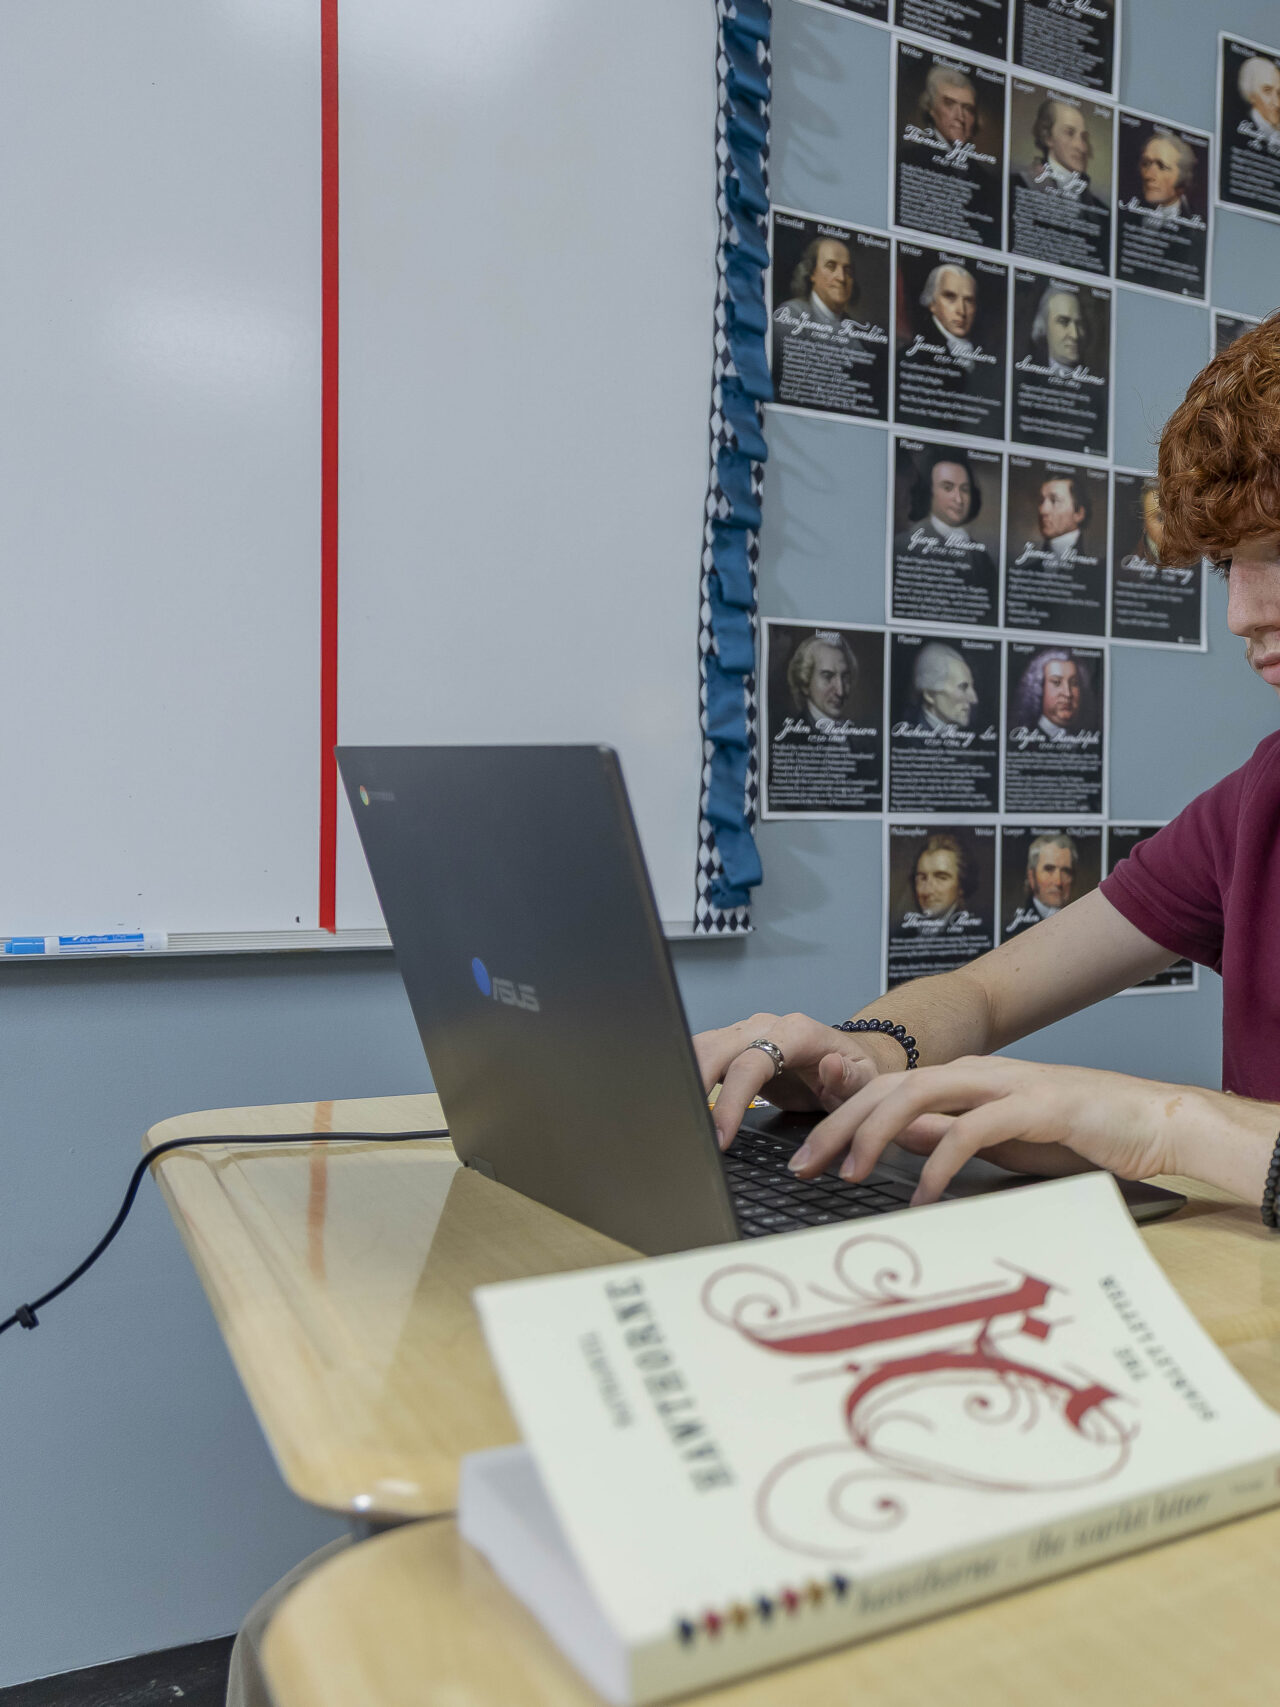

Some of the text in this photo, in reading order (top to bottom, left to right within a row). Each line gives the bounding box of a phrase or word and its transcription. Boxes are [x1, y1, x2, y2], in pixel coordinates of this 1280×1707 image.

[817, 224, 850, 240] Publisher
[838, 318, 888, 344] Franklin
[906, 335, 946, 357] James
[1015, 355, 1105, 385] Samuel Adams
[774, 717, 878, 742] John Dickinson
[891, 721, 940, 738] Richard
[902, 911, 982, 929] Thomas Paine
[1006, 908, 1041, 931] John
[604, 1275, 738, 1495] HAWTHORNE
